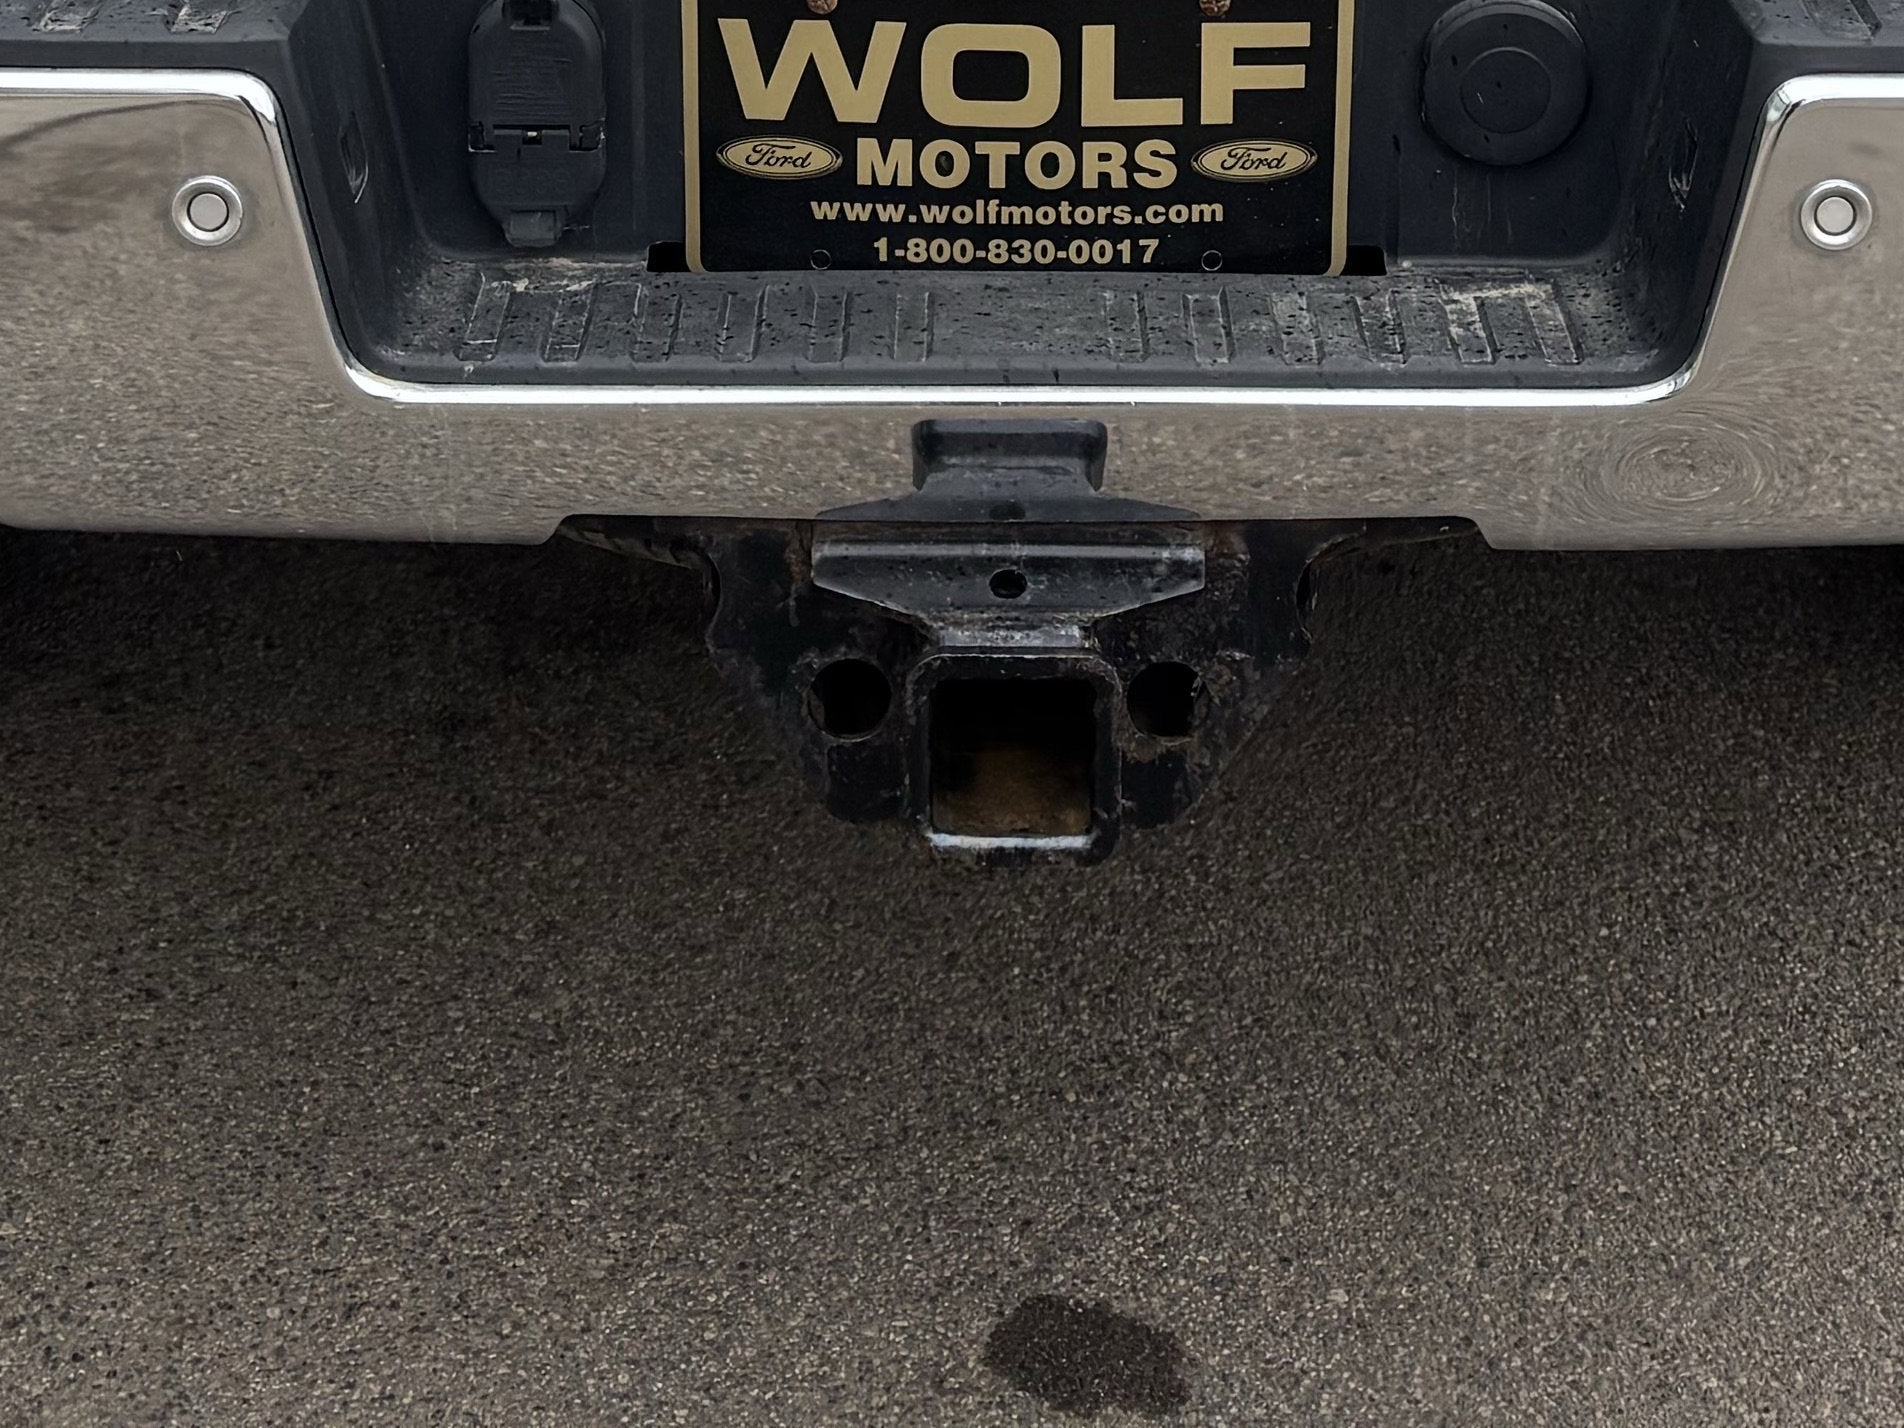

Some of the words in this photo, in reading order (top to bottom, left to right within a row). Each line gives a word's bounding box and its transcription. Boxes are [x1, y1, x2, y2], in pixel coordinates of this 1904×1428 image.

[716, 17, 1312, 130] WOLF
[744, 142, 814, 169] Ford
[855, 137, 1179, 191] MOTORS
[1220, 146, 1289, 171] Ford
[809, 198, 1225, 227] www.wolfmotors.com
[872, 236, 1162, 266] 1-800-830-0017
